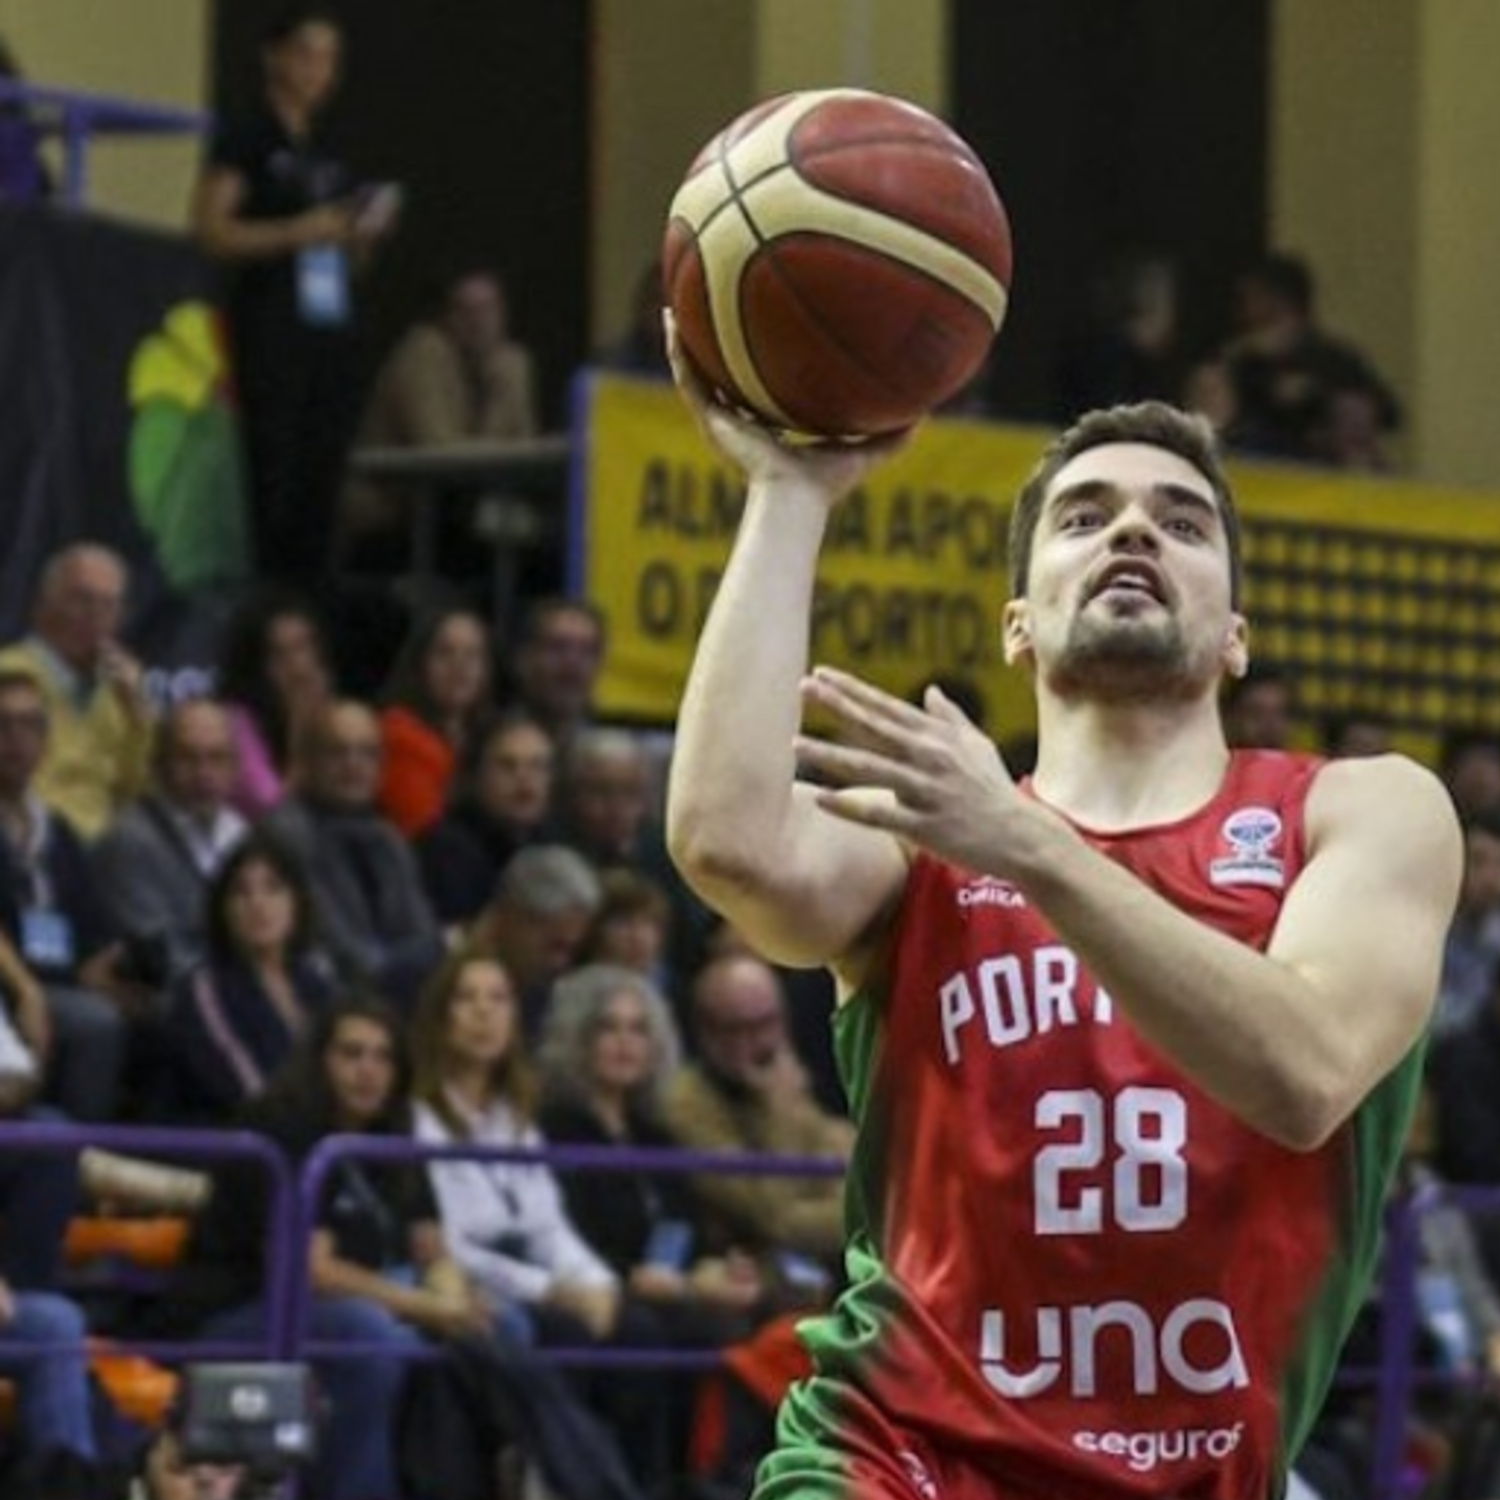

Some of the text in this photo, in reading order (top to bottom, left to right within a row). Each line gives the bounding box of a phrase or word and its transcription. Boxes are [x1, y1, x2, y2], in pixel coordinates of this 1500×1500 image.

[639, 562, 682, 638] O
[1034, 1086, 1188, 1235] 28
[980, 1298, 1249, 1398] una
